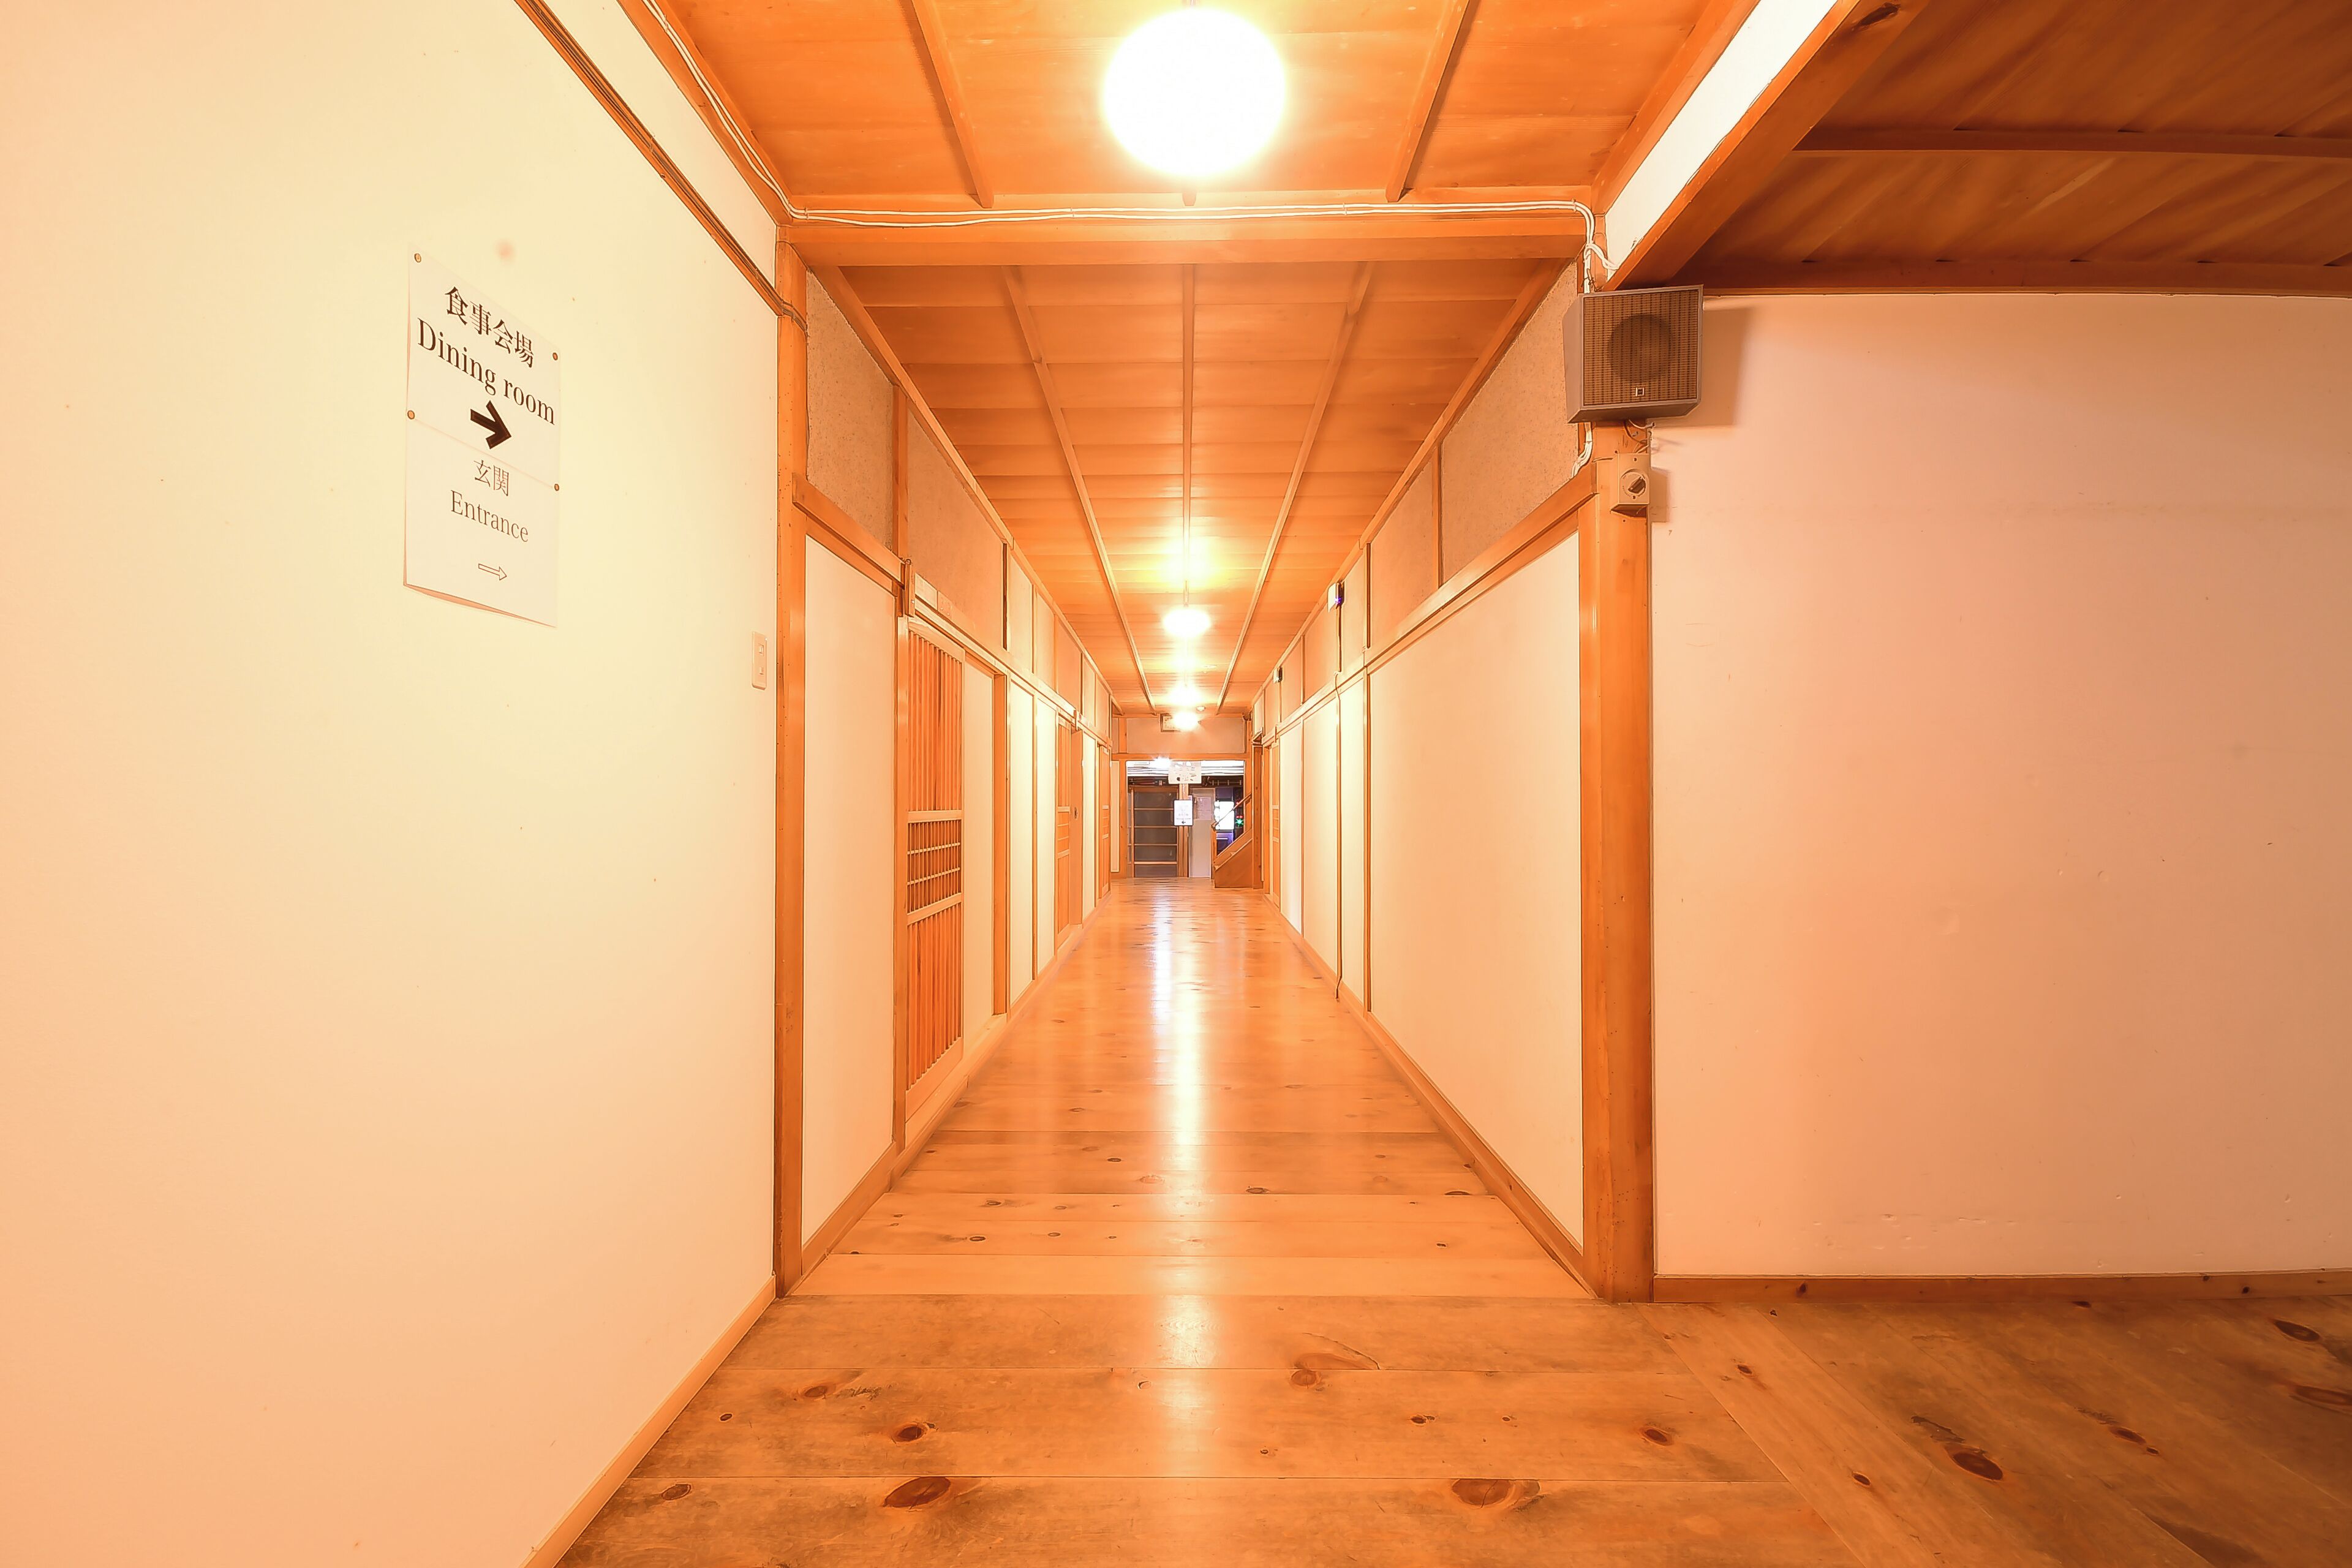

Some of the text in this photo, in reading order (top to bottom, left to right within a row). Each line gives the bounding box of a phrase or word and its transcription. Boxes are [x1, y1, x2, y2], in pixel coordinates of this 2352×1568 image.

[444, 286, 534, 368] 食事会場
[417, 317, 555, 426] Dining room
[473, 459, 510, 497] 玄関
[450, 489, 529, 543] Entrance
